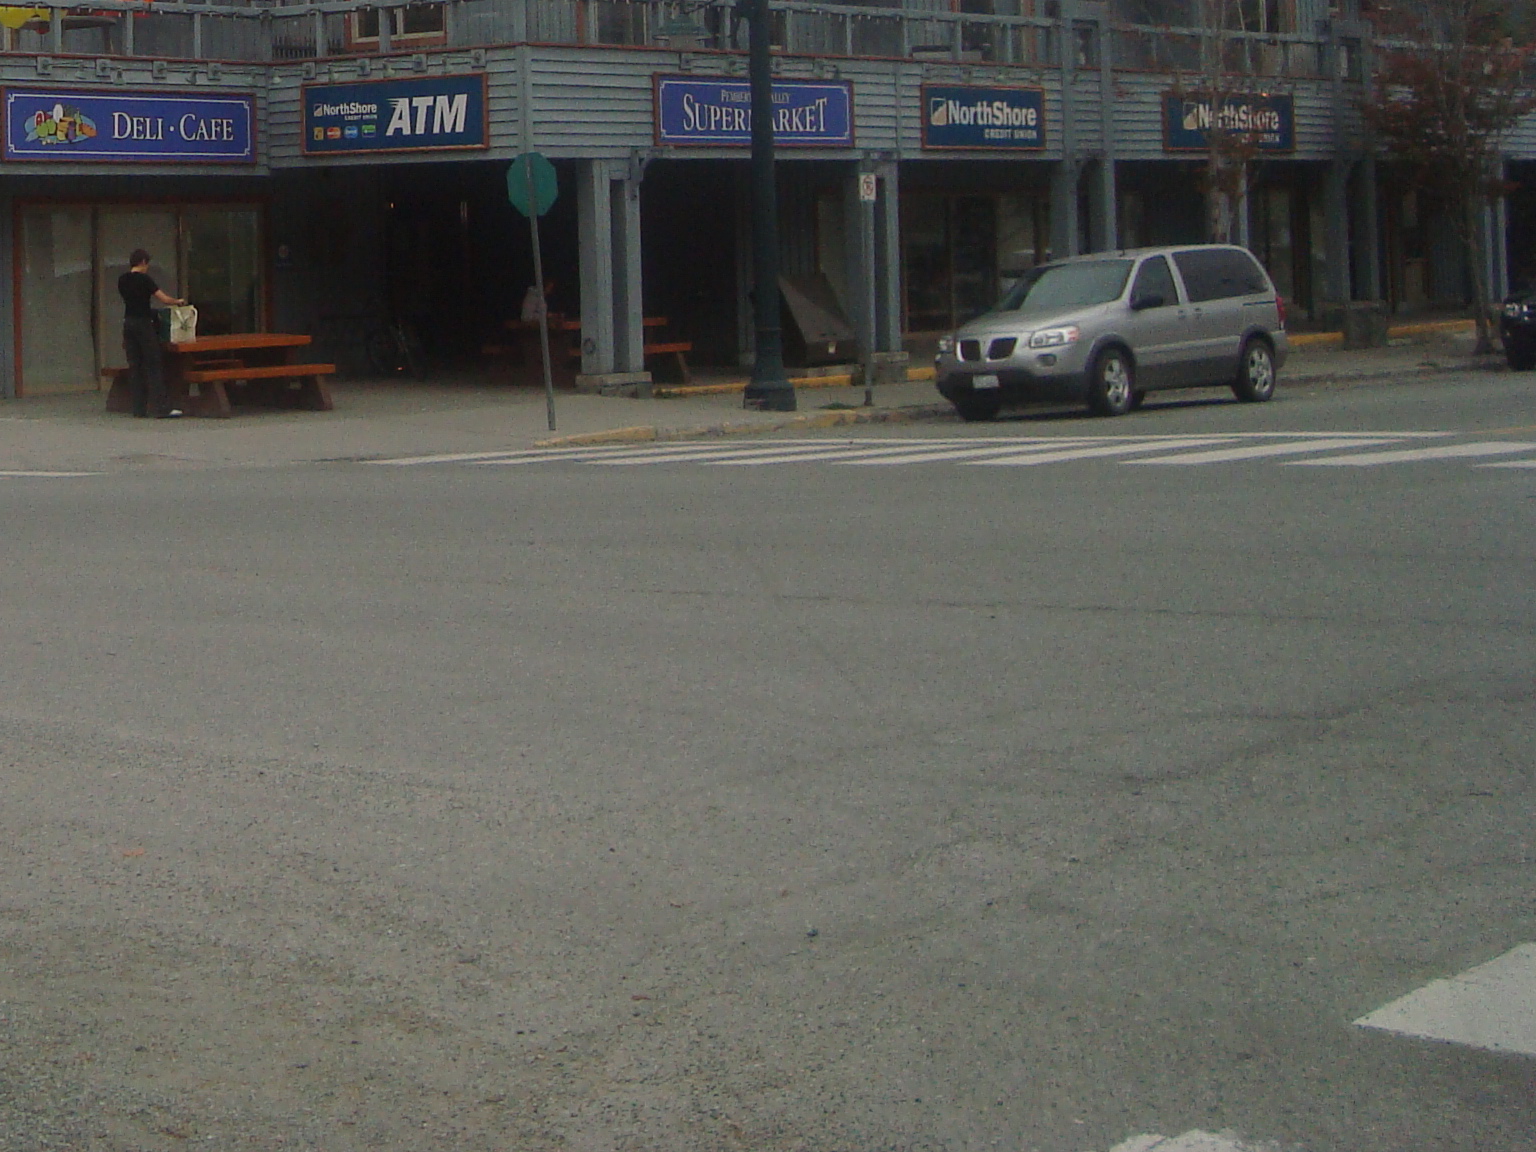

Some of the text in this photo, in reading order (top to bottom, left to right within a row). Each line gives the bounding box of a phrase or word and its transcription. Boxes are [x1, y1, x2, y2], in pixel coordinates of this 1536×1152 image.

[323, 102, 378, 116] NorthShore
[385, 94, 467, 136] ATM
[948, 100, 1037, 126] NorthShore
[112, 112, 234, 141] DELI CAFE
